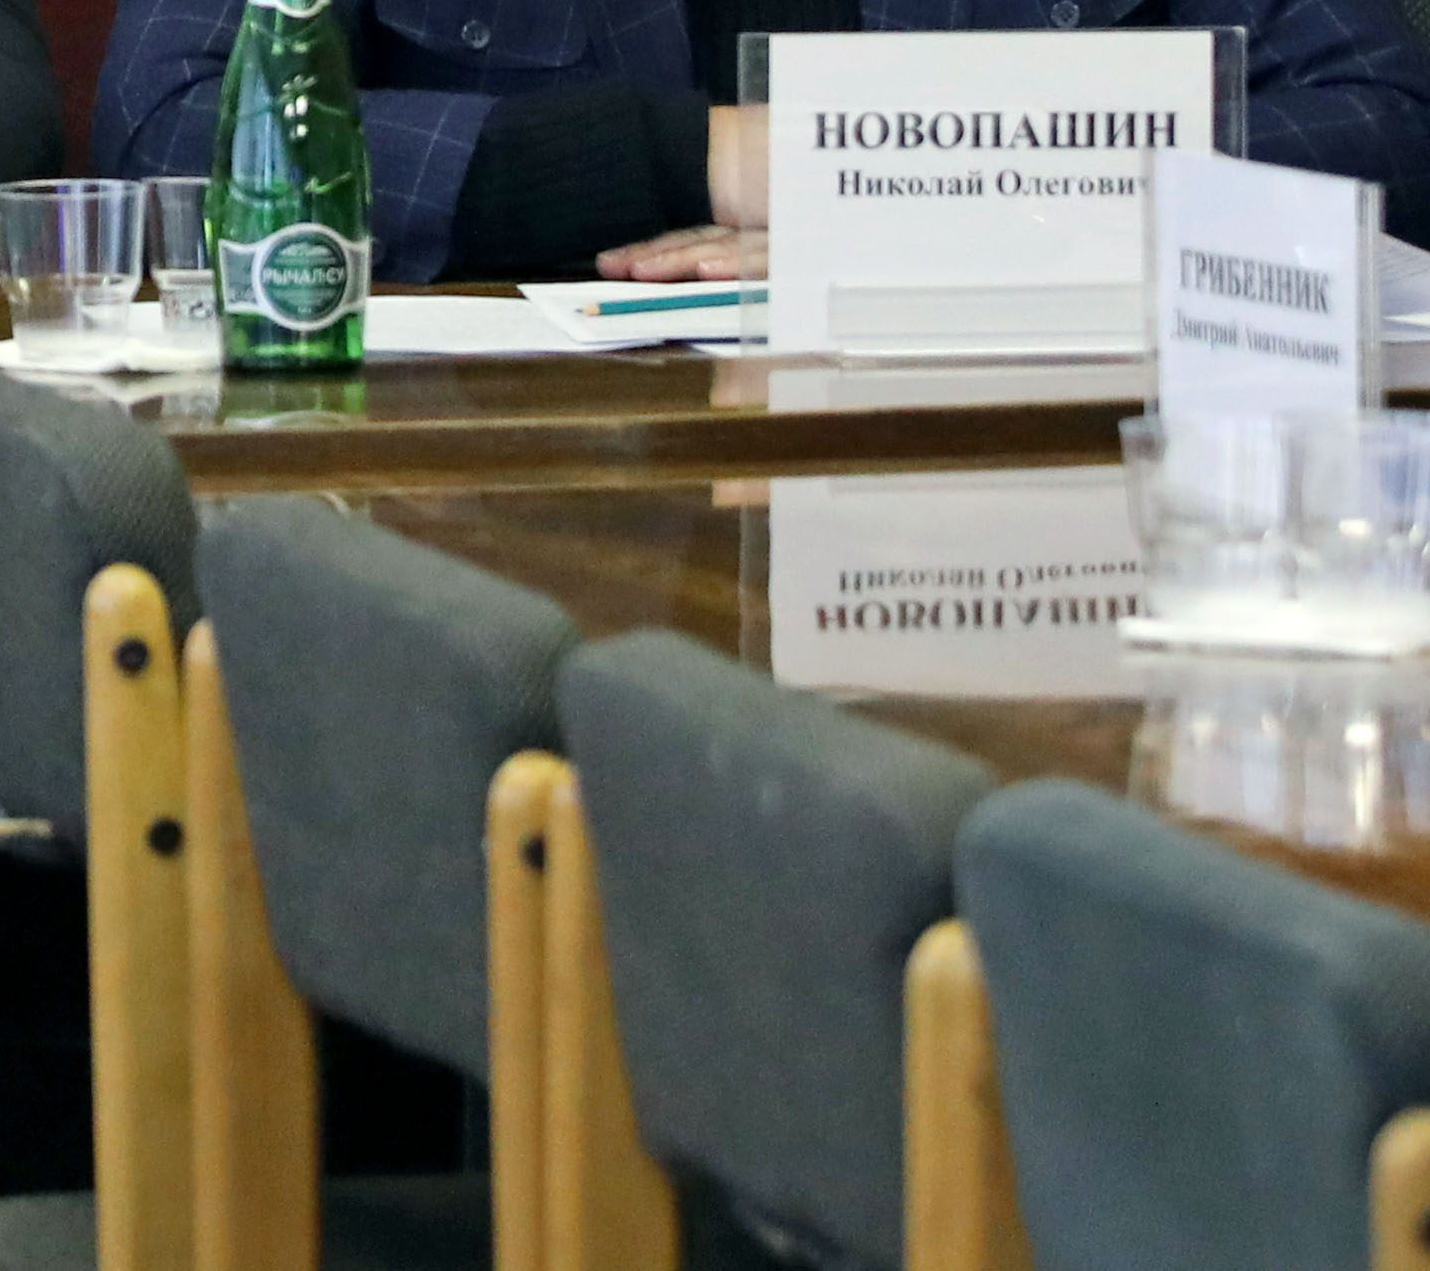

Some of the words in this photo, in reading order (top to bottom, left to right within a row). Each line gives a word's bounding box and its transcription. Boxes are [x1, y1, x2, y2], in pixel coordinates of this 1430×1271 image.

[813, 110, 1179, 151] НОВОПАШИН
[836, 168, 984, 198] Николай
[1178, 247, 1331, 314] ГРИБЕННИК
